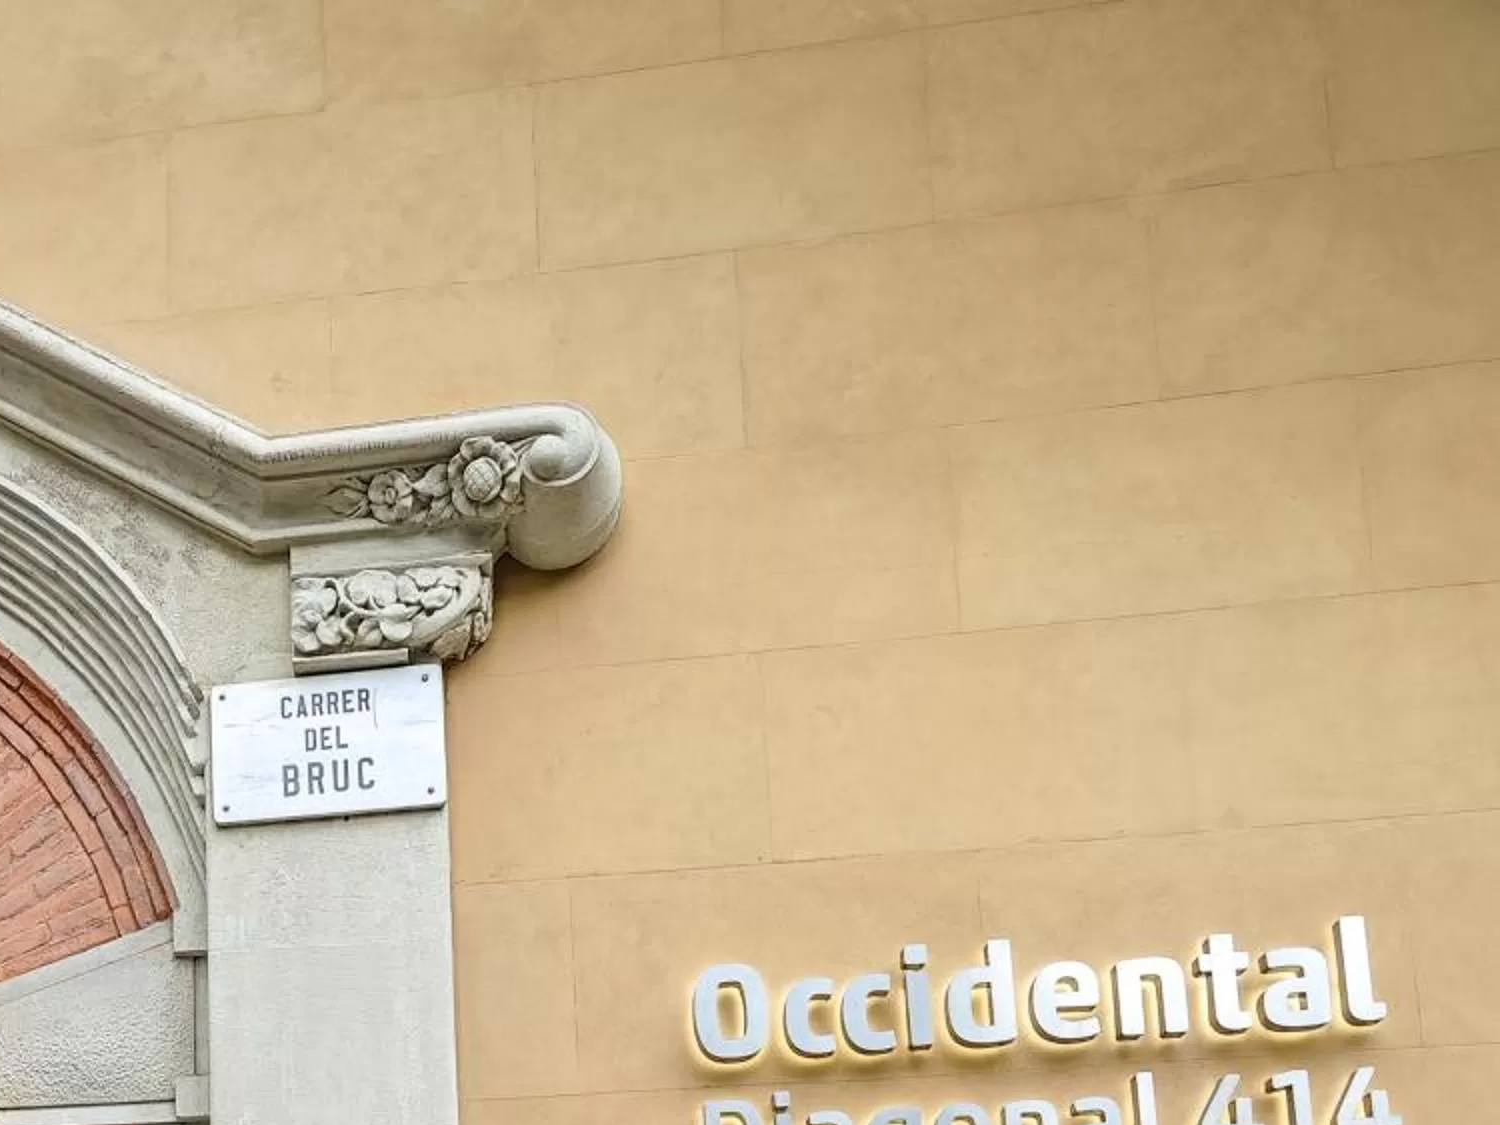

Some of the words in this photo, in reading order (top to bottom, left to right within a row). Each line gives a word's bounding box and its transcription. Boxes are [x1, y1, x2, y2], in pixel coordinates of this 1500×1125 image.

[280, 687, 371, 720] CARRER
[304, 725, 349, 752] DEL
[282, 756, 376, 798] BRUC
[692, 914, 1388, 1063] Occidental
